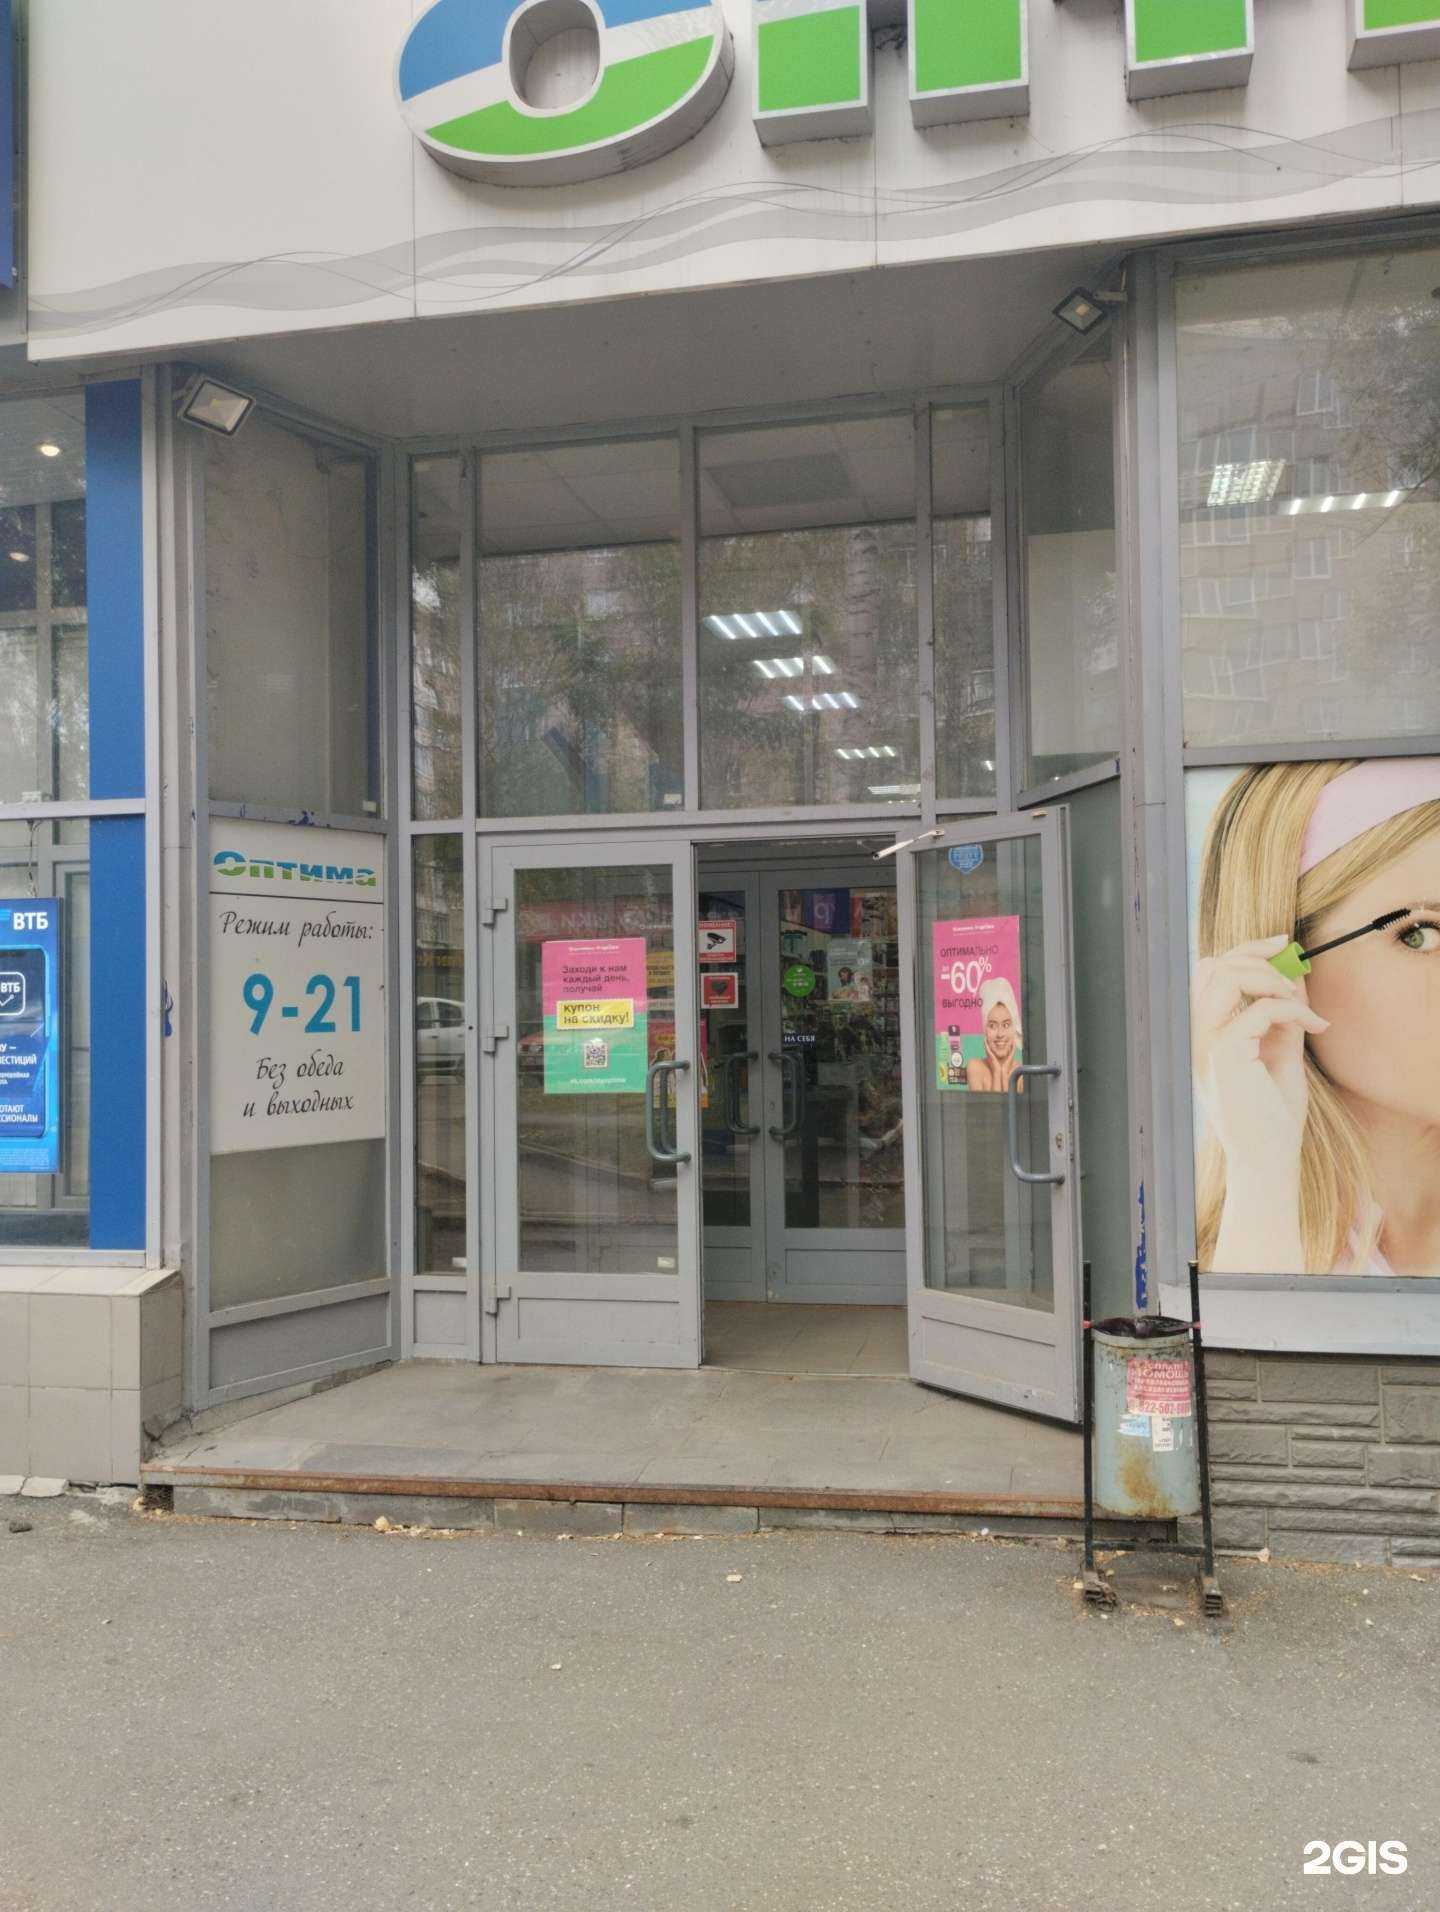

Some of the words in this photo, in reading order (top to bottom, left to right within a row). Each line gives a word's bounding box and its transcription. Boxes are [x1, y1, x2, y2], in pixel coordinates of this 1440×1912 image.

[213, 850, 377, 887] Оптима
[13, 911, 49, 931] ВТБ
[219, 910, 290, 936] Режим
[297, 910, 374, 948] работы:
[0, 982, 21, 993] ВТБ
[243, 973, 360, 1035] 9-21
[563, 1003, 600, 1014] купон
[942, 998, 984, 1009] ВЫГОДНО
[256, 1056, 288, 1090] Без
[296, 1050, 344, 1080] обеда
[243, 1100, 256, 1117] и
[266, 1090, 354, 1118] выходных
